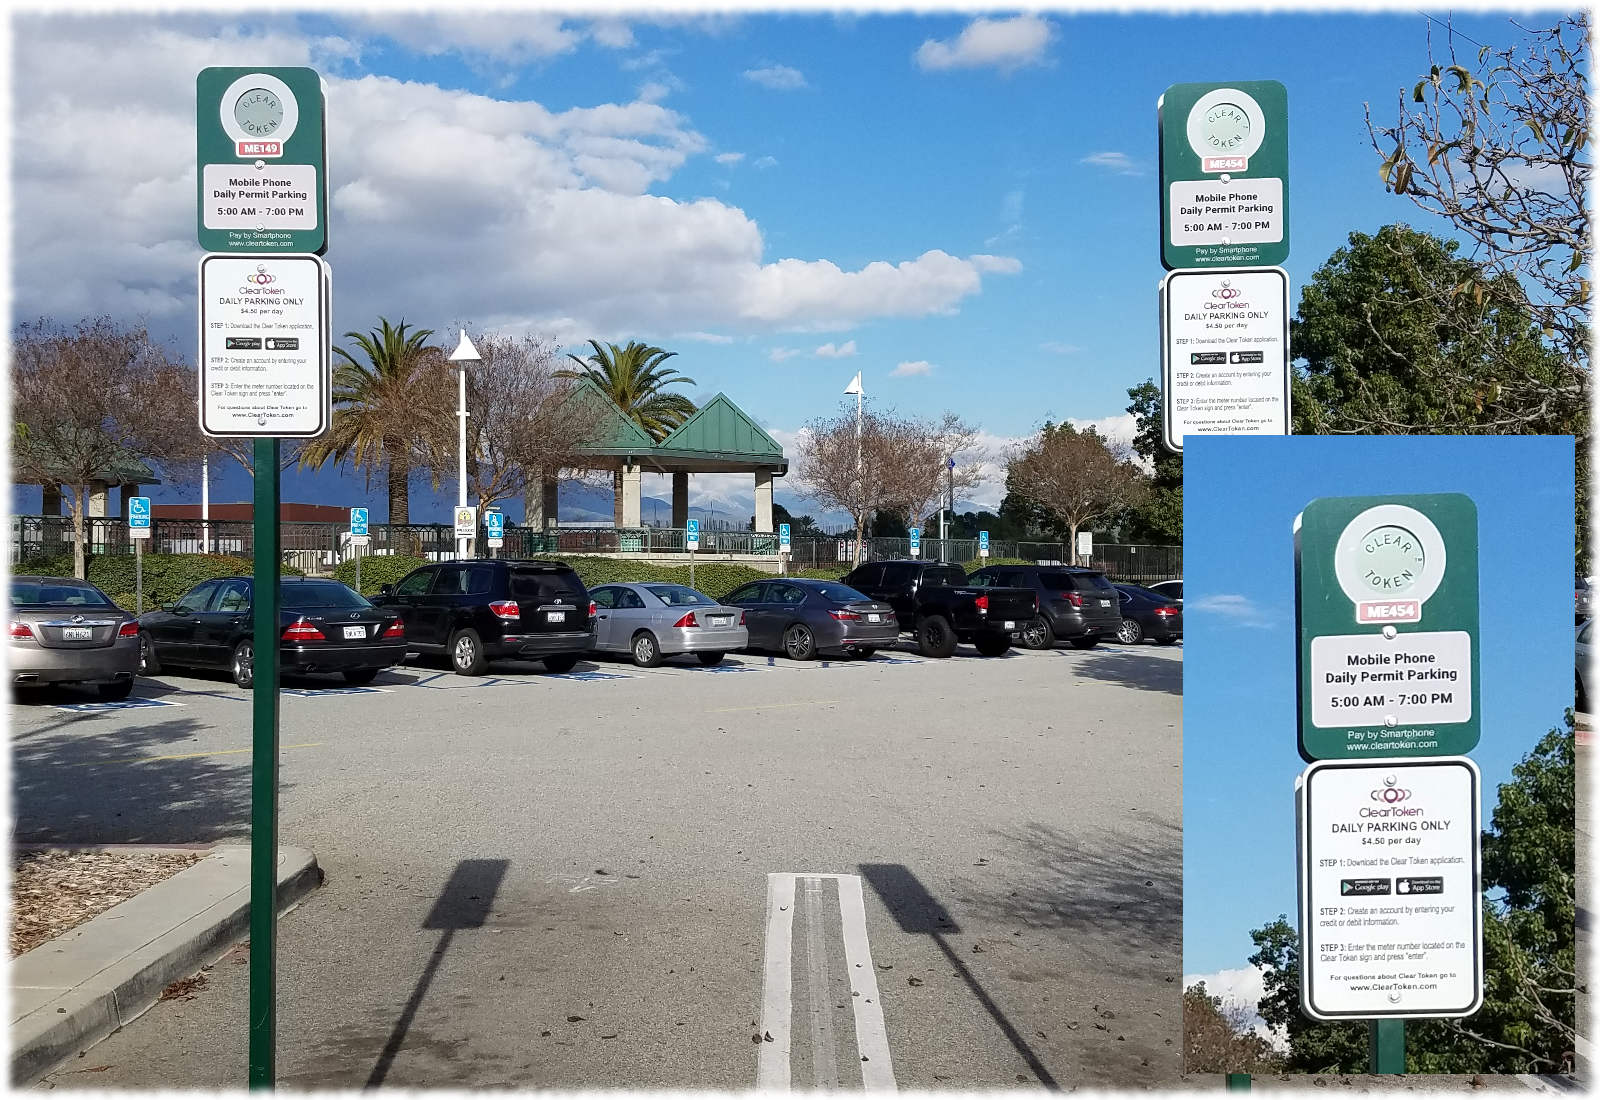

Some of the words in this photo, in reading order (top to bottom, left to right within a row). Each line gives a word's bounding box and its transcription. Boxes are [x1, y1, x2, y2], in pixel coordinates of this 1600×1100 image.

[243, 95, 276, 108] CLEAR
[1209, 110, 1241, 123] CLEAR
[243, 120, 277, 133] TOKEN
[1208, 135, 1242, 147] TOKEN
[214, 190, 236, 200] Daily
[272, 191, 307, 200] Parking
[1196, 194, 1226, 202] Mobile
[1229, 193, 1257, 201] Phone
[1180, 207, 1202, 216] Daily
[1238, 204, 1273, 213] Parking
[1366, 534, 1412, 553] CLEAR
[1365, 570, 1413, 588] TOKEN
[1367, 605, 1414, 617] ME454
[1348, 654, 1390, 665] Mobile
[1395, 653, 1435, 664] Phone
[1326, 672, 1357, 684] Daily
[1361, 670, 1404, 682] Permit
[1408, 668, 1457, 680] Parking
[1331, 697, 1359, 708] 5:00
[1364, 696, 1384, 706] AM
[1399, 694, 1427, 705] 7:00
[1432, 693, 1452, 703] PM
[1348, 731, 1365, 740] Pay
[1368, 730, 1378, 740] by
[1380, 729, 1434, 740] Smartphone
[1347, 740, 1438, 750] www.cleartoken.com
[1359, 807, 1423, 818] ClearToken
[1332, 824, 1364, 833] DAILY
[1368, 822, 1417, 832] PARKING
[1421, 820, 1450, 830] ONLY
[1405, 836, 1421, 845] day
[1355, 884, 1375, 892] Google
[1406, 906, 1412, 915] by
[1415, 906, 1439, 914] entering
